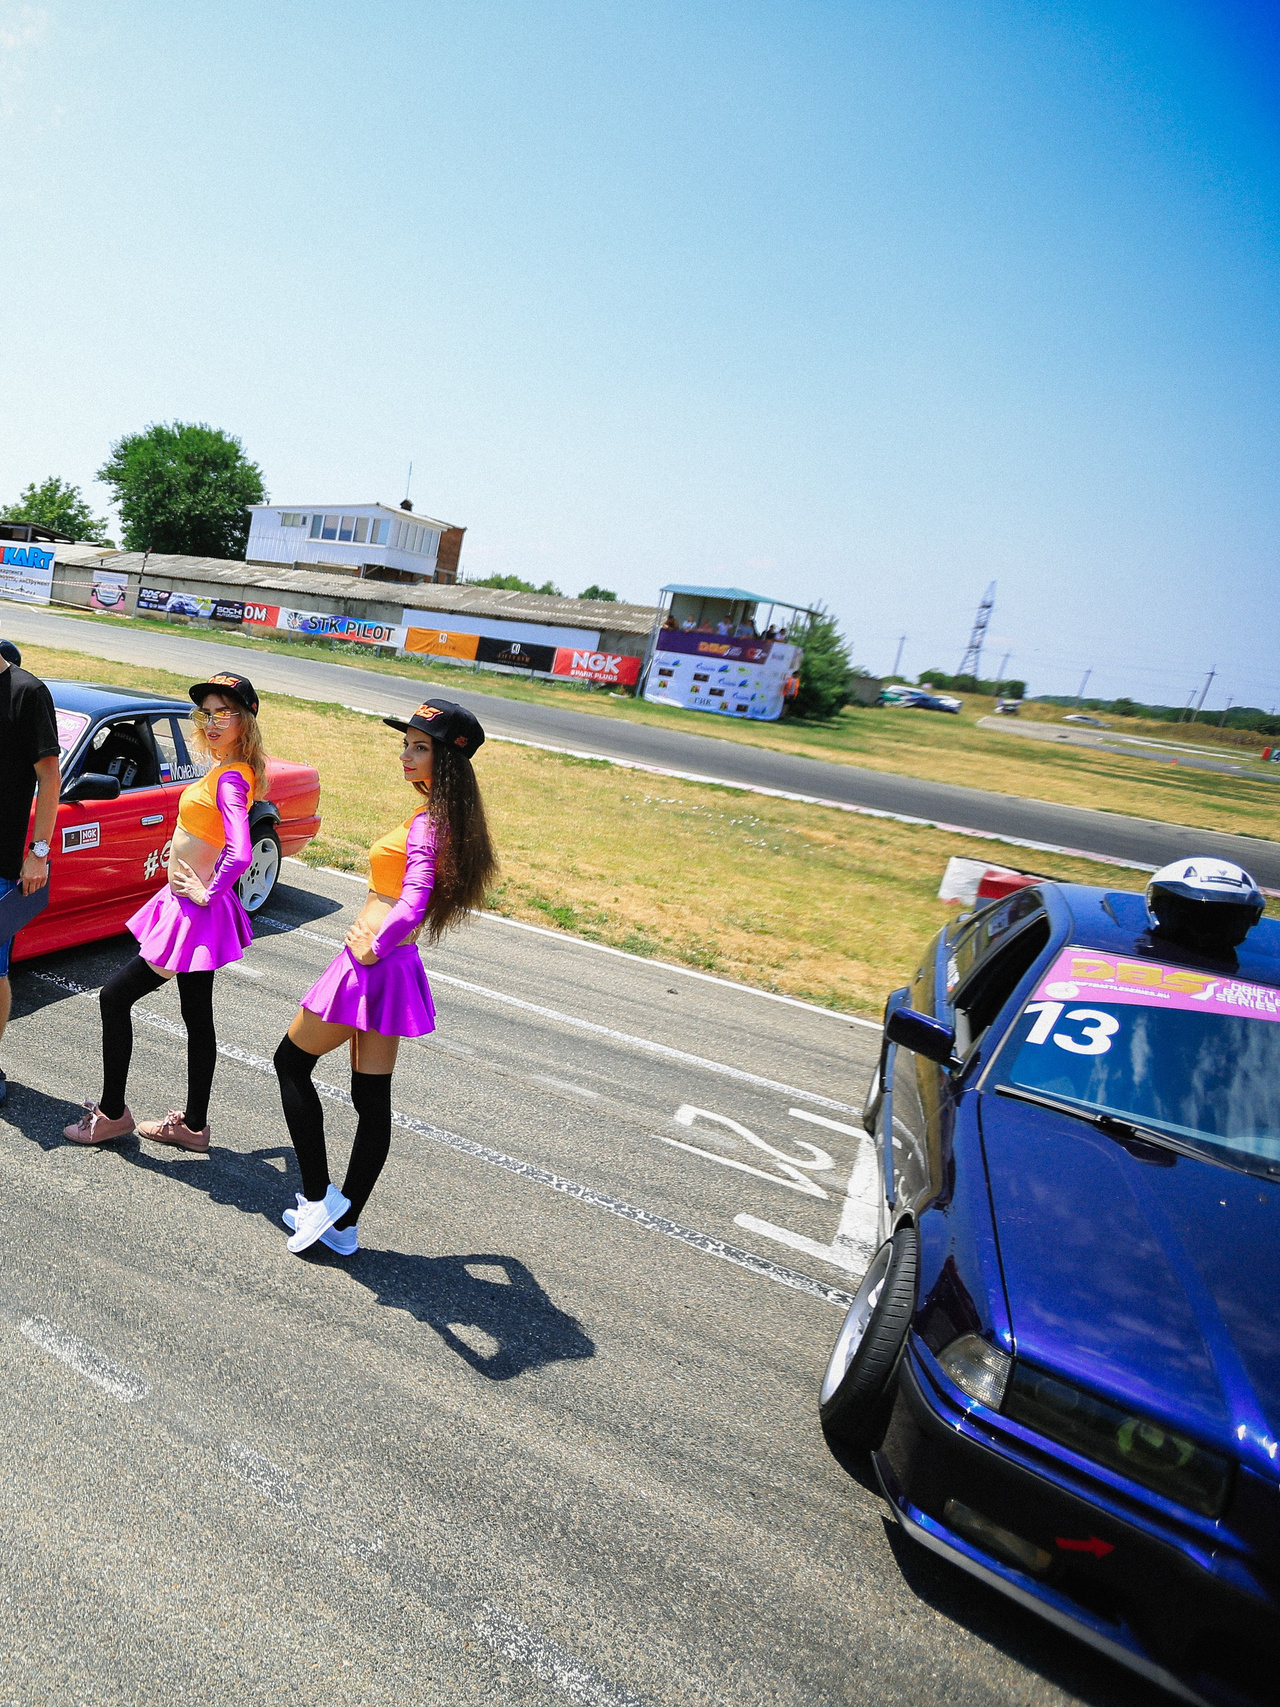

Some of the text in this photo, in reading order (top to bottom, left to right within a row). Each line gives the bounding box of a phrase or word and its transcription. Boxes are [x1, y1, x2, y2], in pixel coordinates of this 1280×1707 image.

[216, 606, 243, 615] SOCHI
[308, 616, 396, 642] STK PILOT
[571, 651, 622, 675] NGK
[570, 669, 618, 682] SPARK PLUGS
[82, 829, 97, 838] NGK
[1071, 957, 1278, 999] DBS DRIFT
[1214, 992, 1278, 1014] SERIES
[1023, 1001, 1121, 1056] 13
